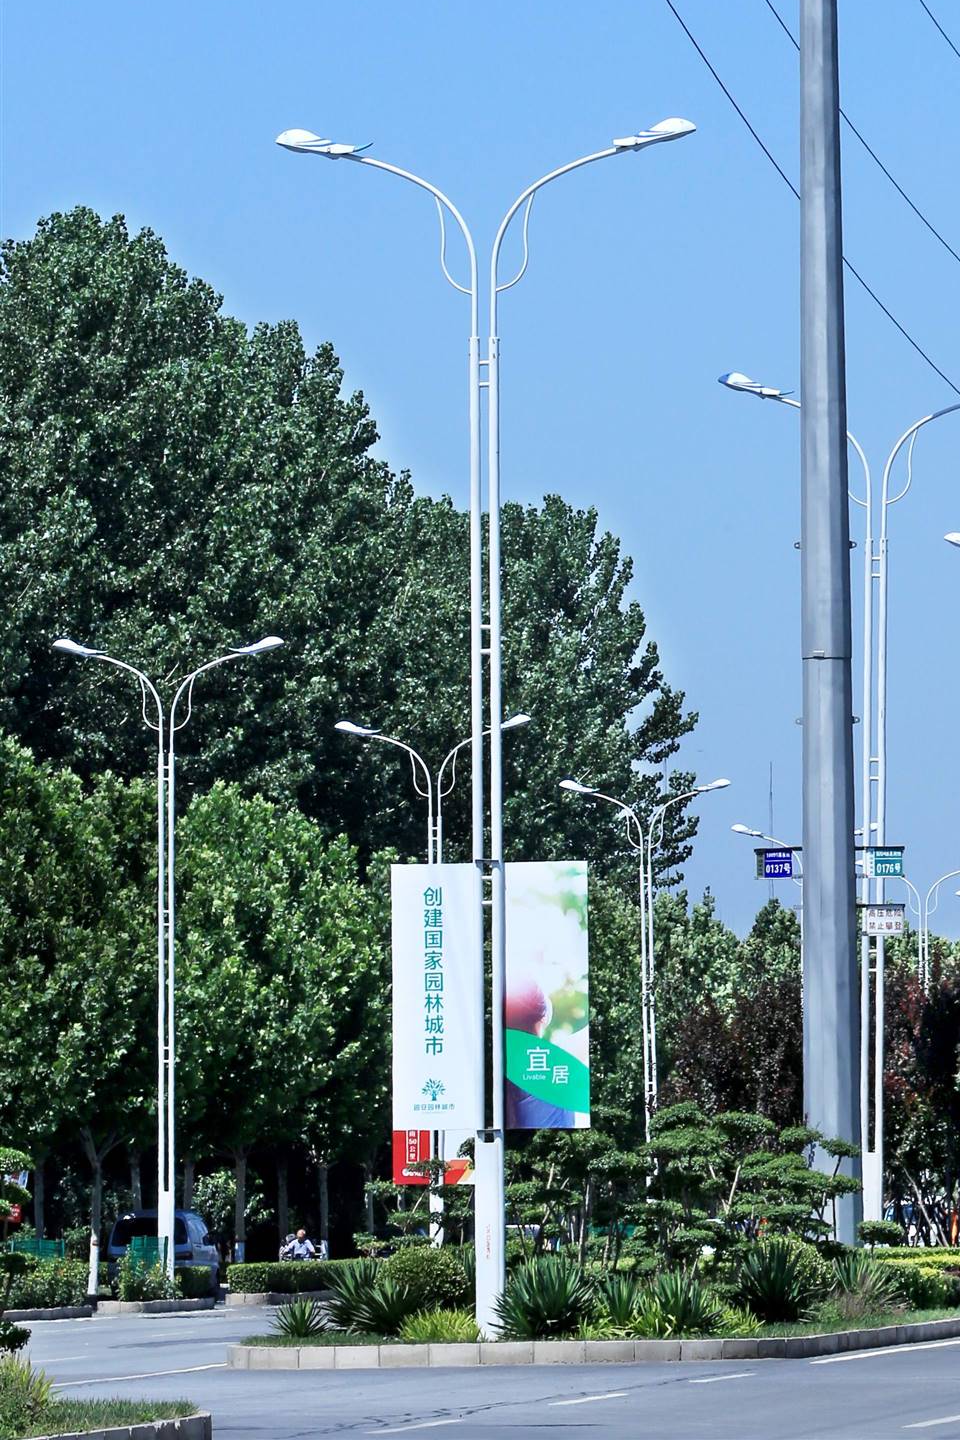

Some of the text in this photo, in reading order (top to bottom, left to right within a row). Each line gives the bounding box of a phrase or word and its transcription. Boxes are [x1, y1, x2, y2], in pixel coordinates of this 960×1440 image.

[765, 862, 791, 874] 0137号
[423, 886, 444, 1056] 创建国家园林城市
